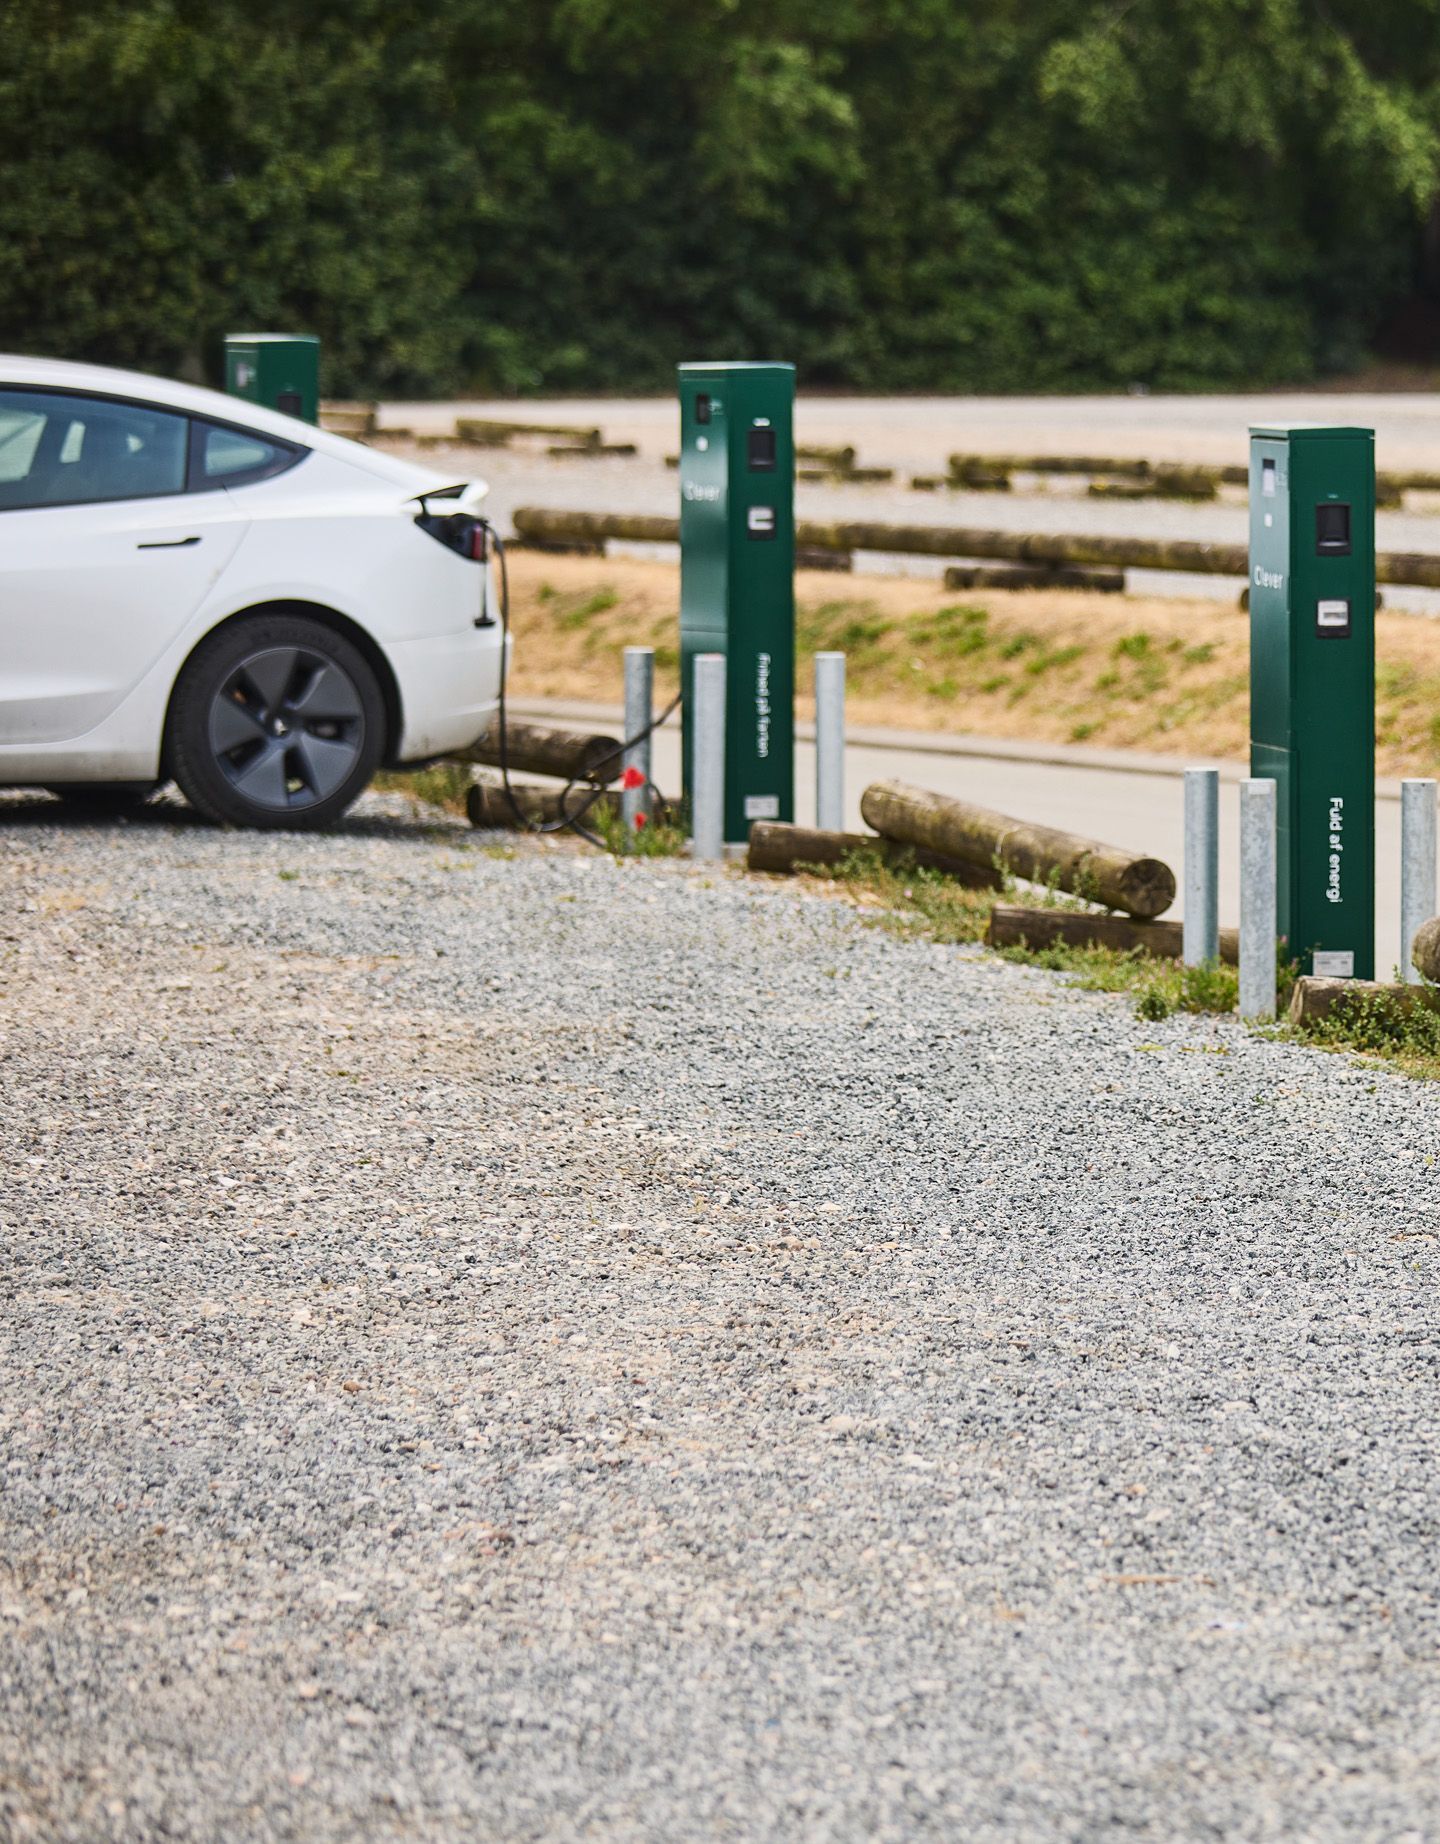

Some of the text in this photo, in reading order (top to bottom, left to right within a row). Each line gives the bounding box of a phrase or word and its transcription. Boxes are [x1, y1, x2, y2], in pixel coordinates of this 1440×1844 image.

[1254, 564, 1284, 589] Clever
[1326, 797, 1343, 903] Fuld af energi
